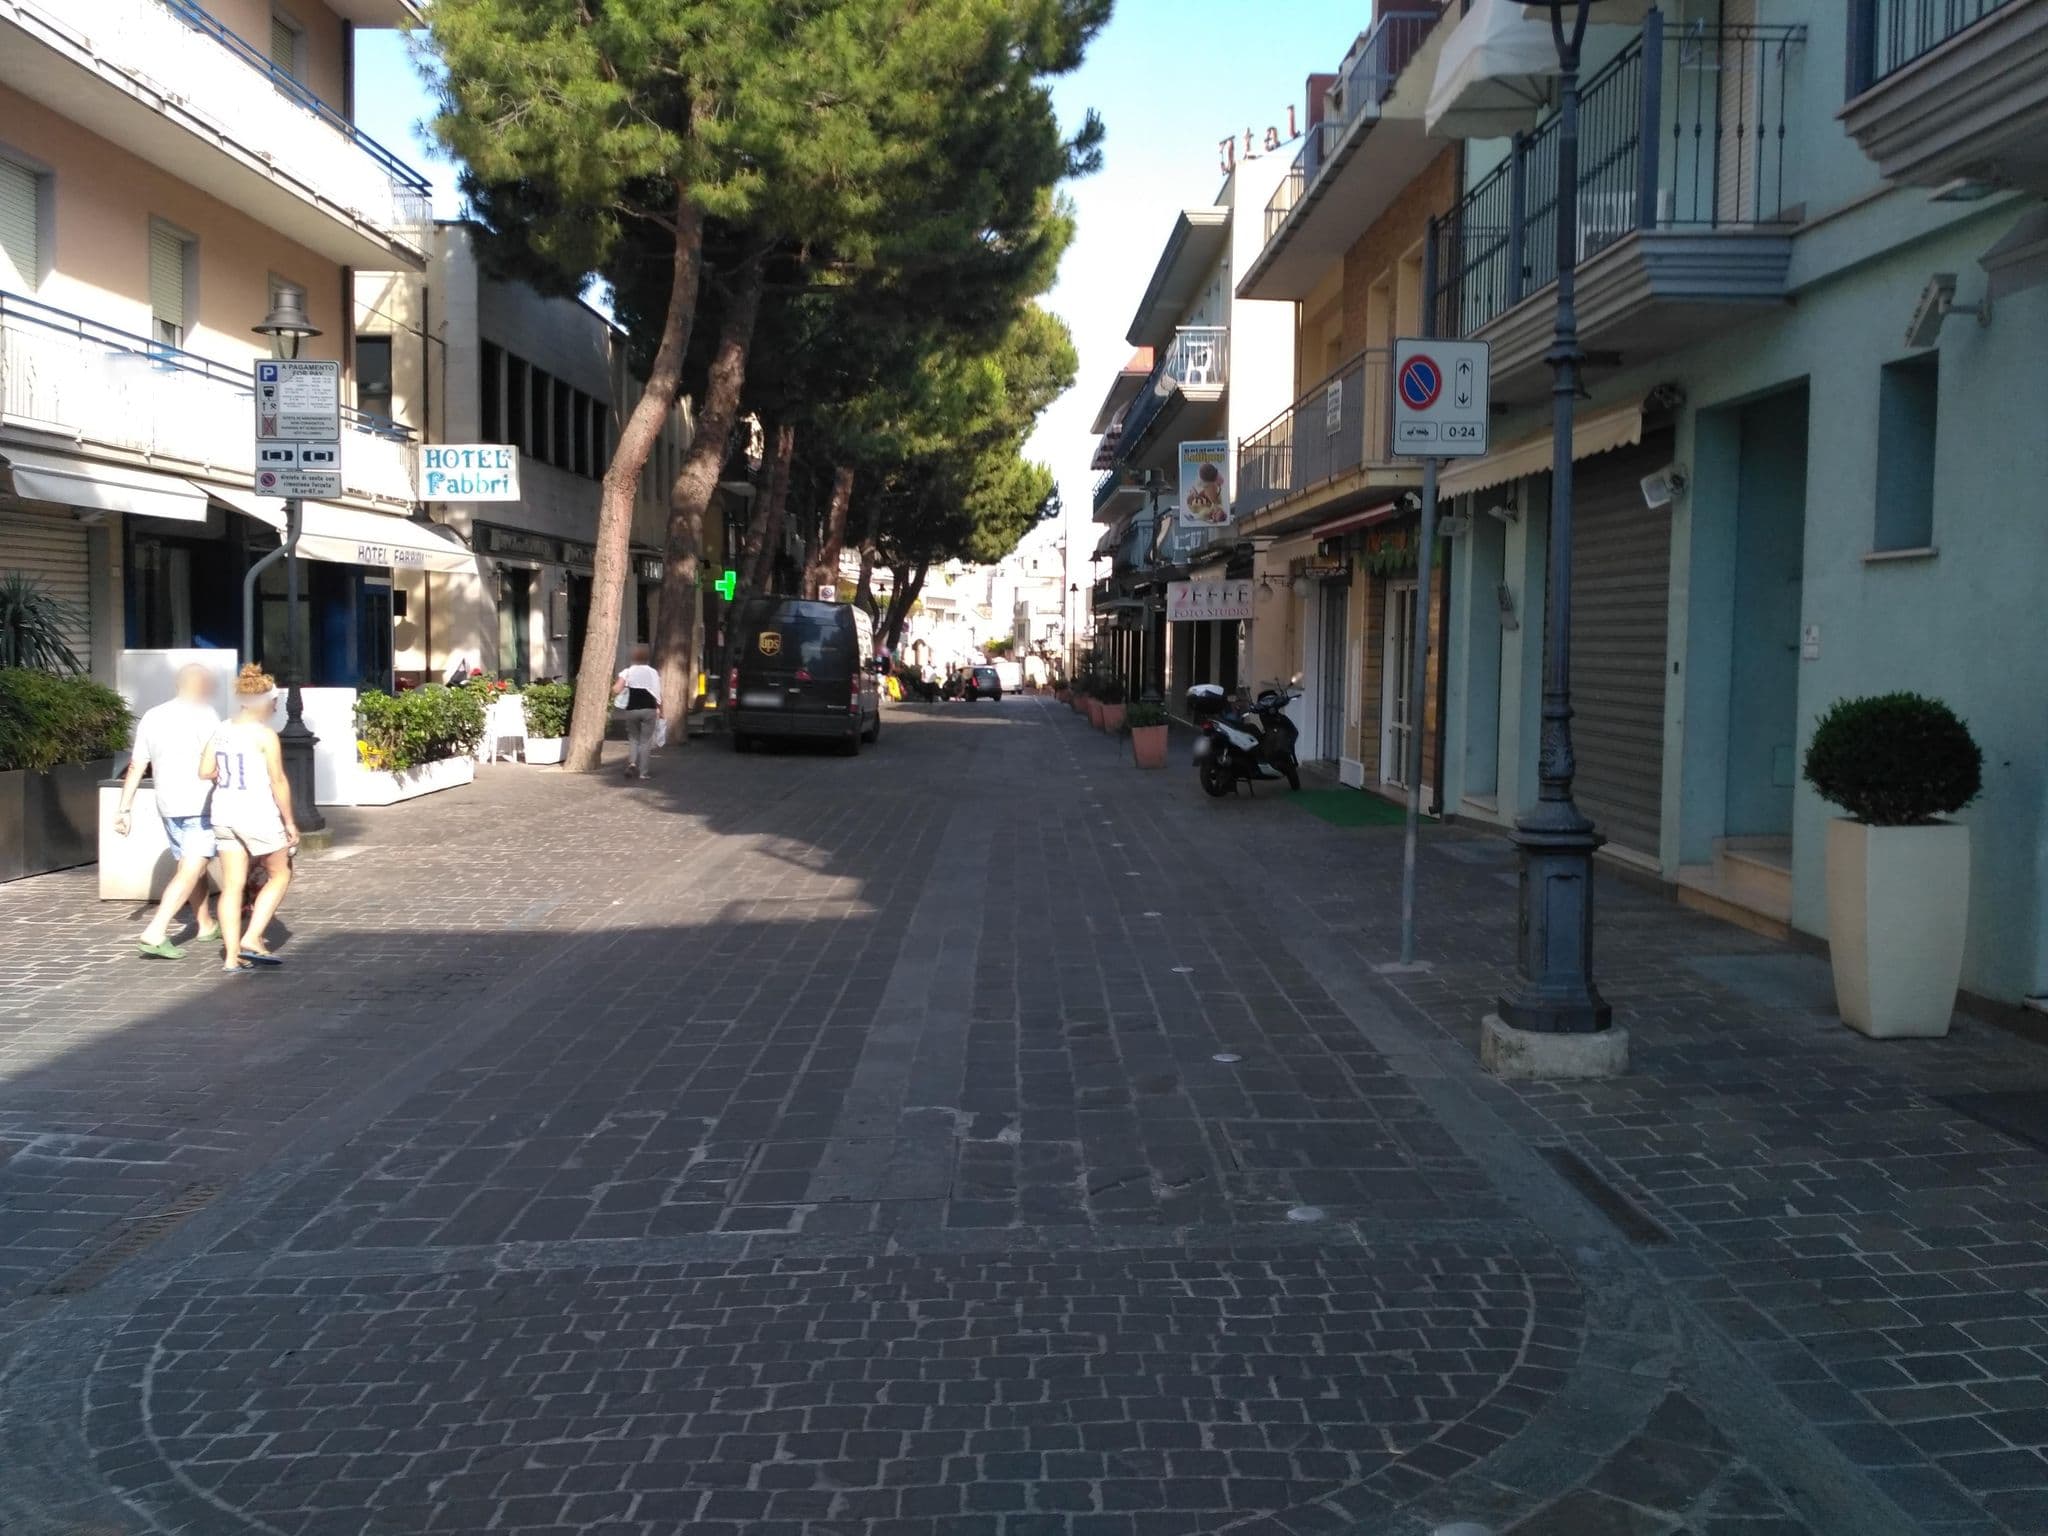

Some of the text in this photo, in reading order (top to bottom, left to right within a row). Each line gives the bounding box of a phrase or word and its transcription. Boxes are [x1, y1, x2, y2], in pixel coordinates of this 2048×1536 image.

[263, 366, 274, 380] P
[288, 363, 335, 372] PAGAMENTO
[1448, 426, 1476, 438] 0-24
[424, 448, 510, 469] HOTEL
[426, 470, 510, 496] Fabbri
[358, 545, 389, 563] HOTEL
[1174, 607, 1249, 618] FOTO STUDIO
